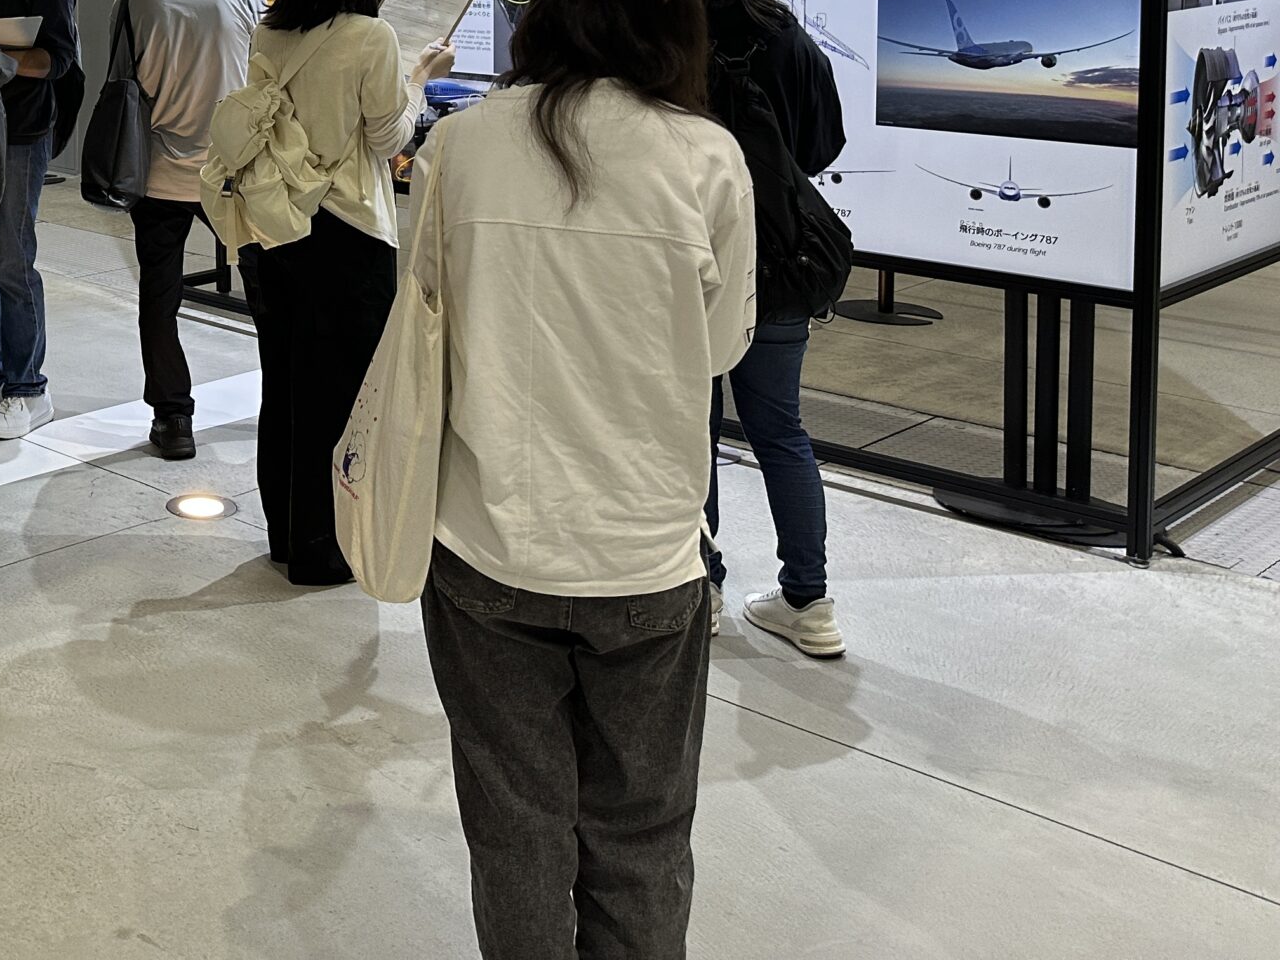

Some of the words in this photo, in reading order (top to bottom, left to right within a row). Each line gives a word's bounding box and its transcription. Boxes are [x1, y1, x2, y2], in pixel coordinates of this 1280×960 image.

[970, 240, 991, 250] Boeing
[1007, 246, 1028, 255] during
[1029, 248, 1047, 257] flight
